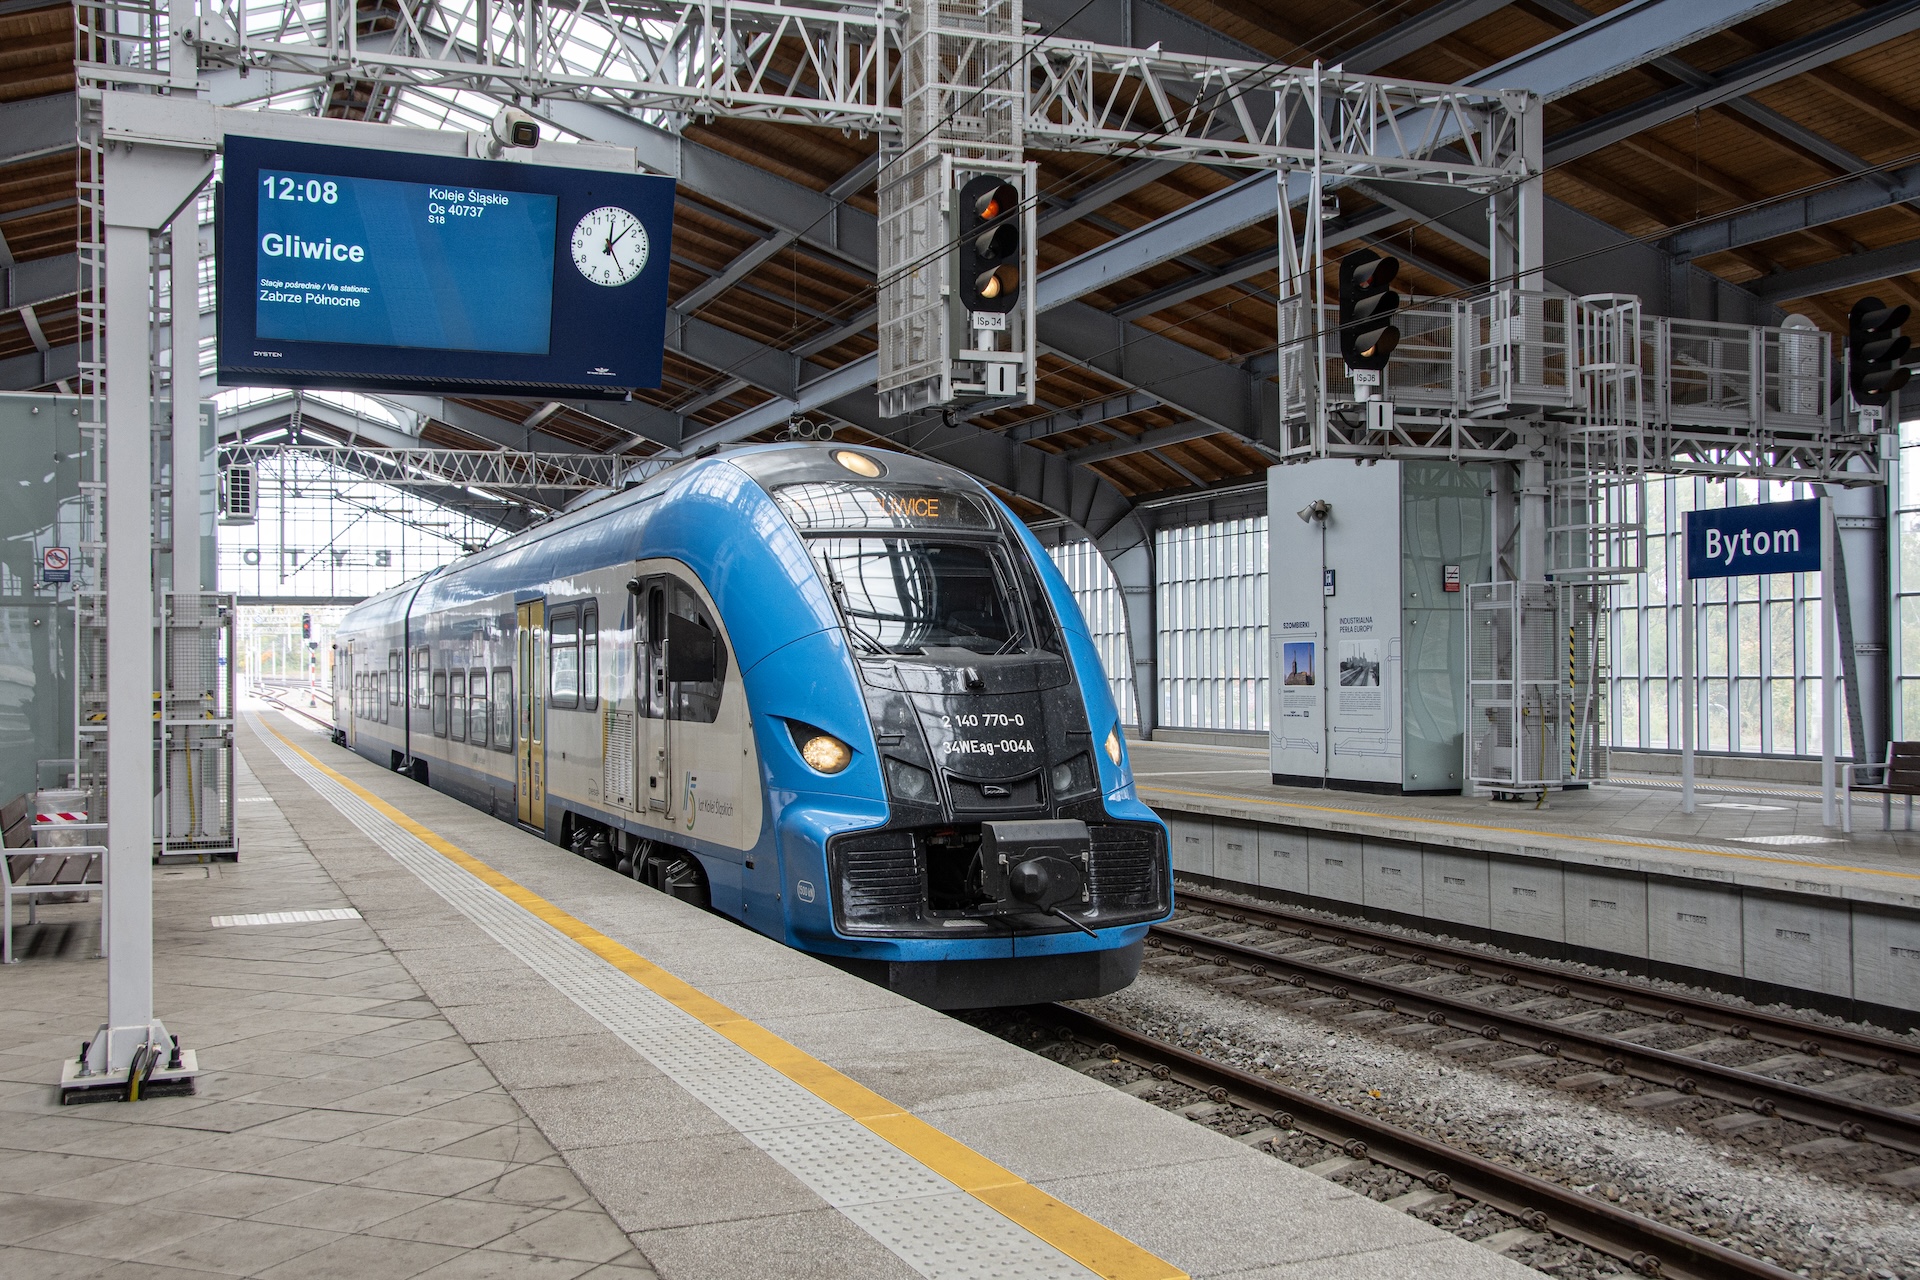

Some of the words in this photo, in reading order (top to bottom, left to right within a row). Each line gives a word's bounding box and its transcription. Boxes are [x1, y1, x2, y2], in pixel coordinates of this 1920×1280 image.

[263, 176, 338, 204] 12:08
[429, 188, 465, 203] Koleje
[467, 189, 509, 206] Śląskie
[428, 203, 446, 214] Os
[448, 205, 484, 217] 40737
[428, 215, 446, 224] S18
[592, 216, 601, 225] 11
[605, 214, 617, 223] 12
[581, 227, 592, 236] 10
[631, 229, 637, 238] 2
[261, 233, 365, 263] Gliwice
[577, 240, 583, 248] 9
[634, 244, 640, 253] 3
[580, 255, 587, 263] 8
[591, 266, 597, 274] 7
[603, 270, 610, 278] 6
[260, 279, 283, 288] Stacje
[284, 281, 321, 290] pośrednie
[340, 285, 371, 293] stations:
[259, 290, 302, 303] Zabrze
[305, 293, 361, 307] Północne
[1706, 528, 1800, 566] Bytom
[1283, 621, 1310, 629] SZOMBIERKI
[1339, 616, 1374, 625] INDUSTRIALNA
[1339, 625, 1354, 633] PERŁA
[942, 715, 952, 728] 2
[955, 714, 979, 727] 140
[982, 714, 1025, 726] 770-0
[942, 740, 1035, 756] 34WEag-004A
